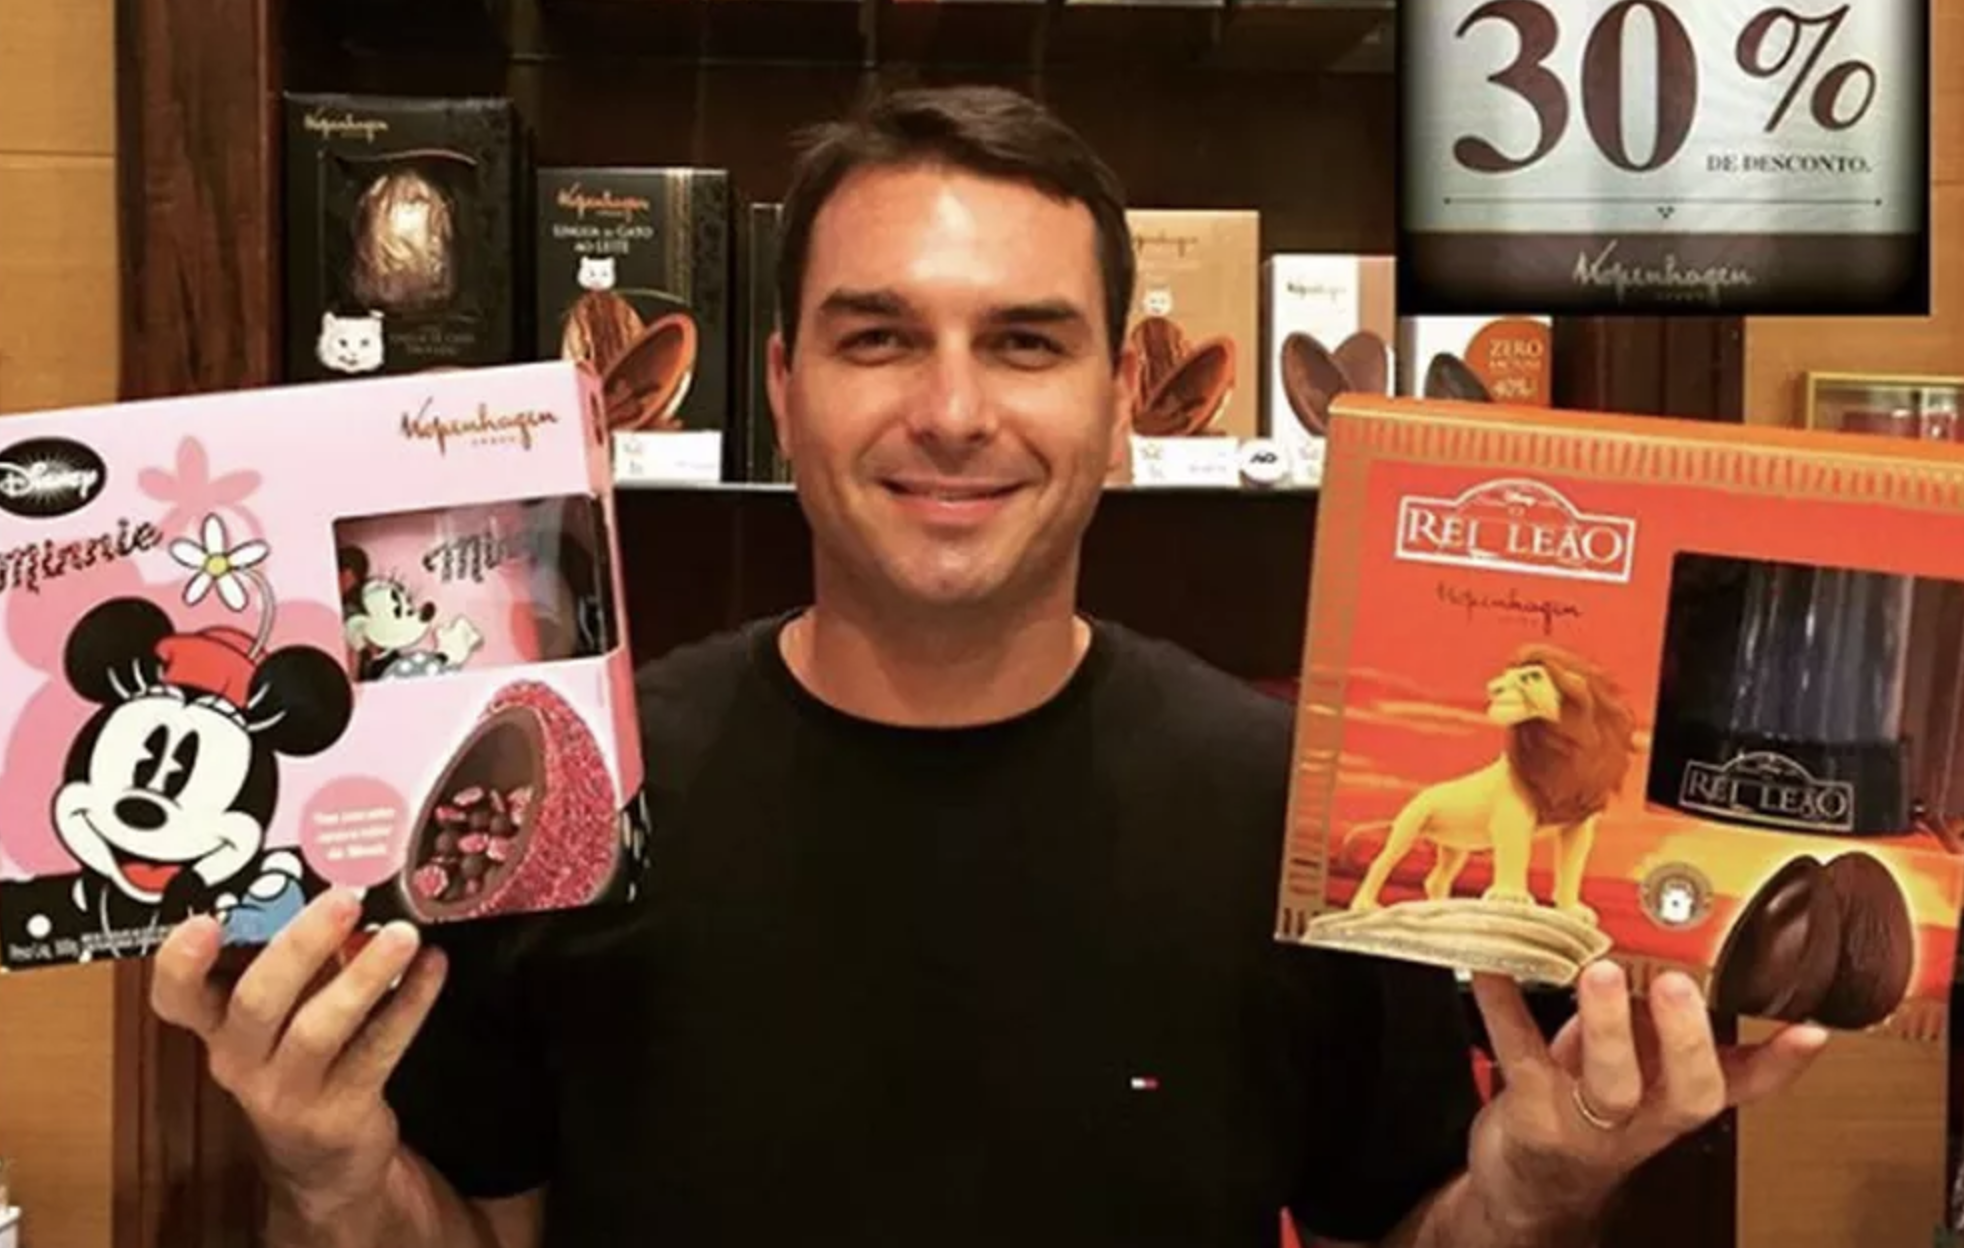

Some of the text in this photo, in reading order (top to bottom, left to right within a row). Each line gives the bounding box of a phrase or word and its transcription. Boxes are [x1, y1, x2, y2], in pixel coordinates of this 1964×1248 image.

[1453, 0, 1877, 173] 30 %
[1706, 154, 1738, 172] DE
